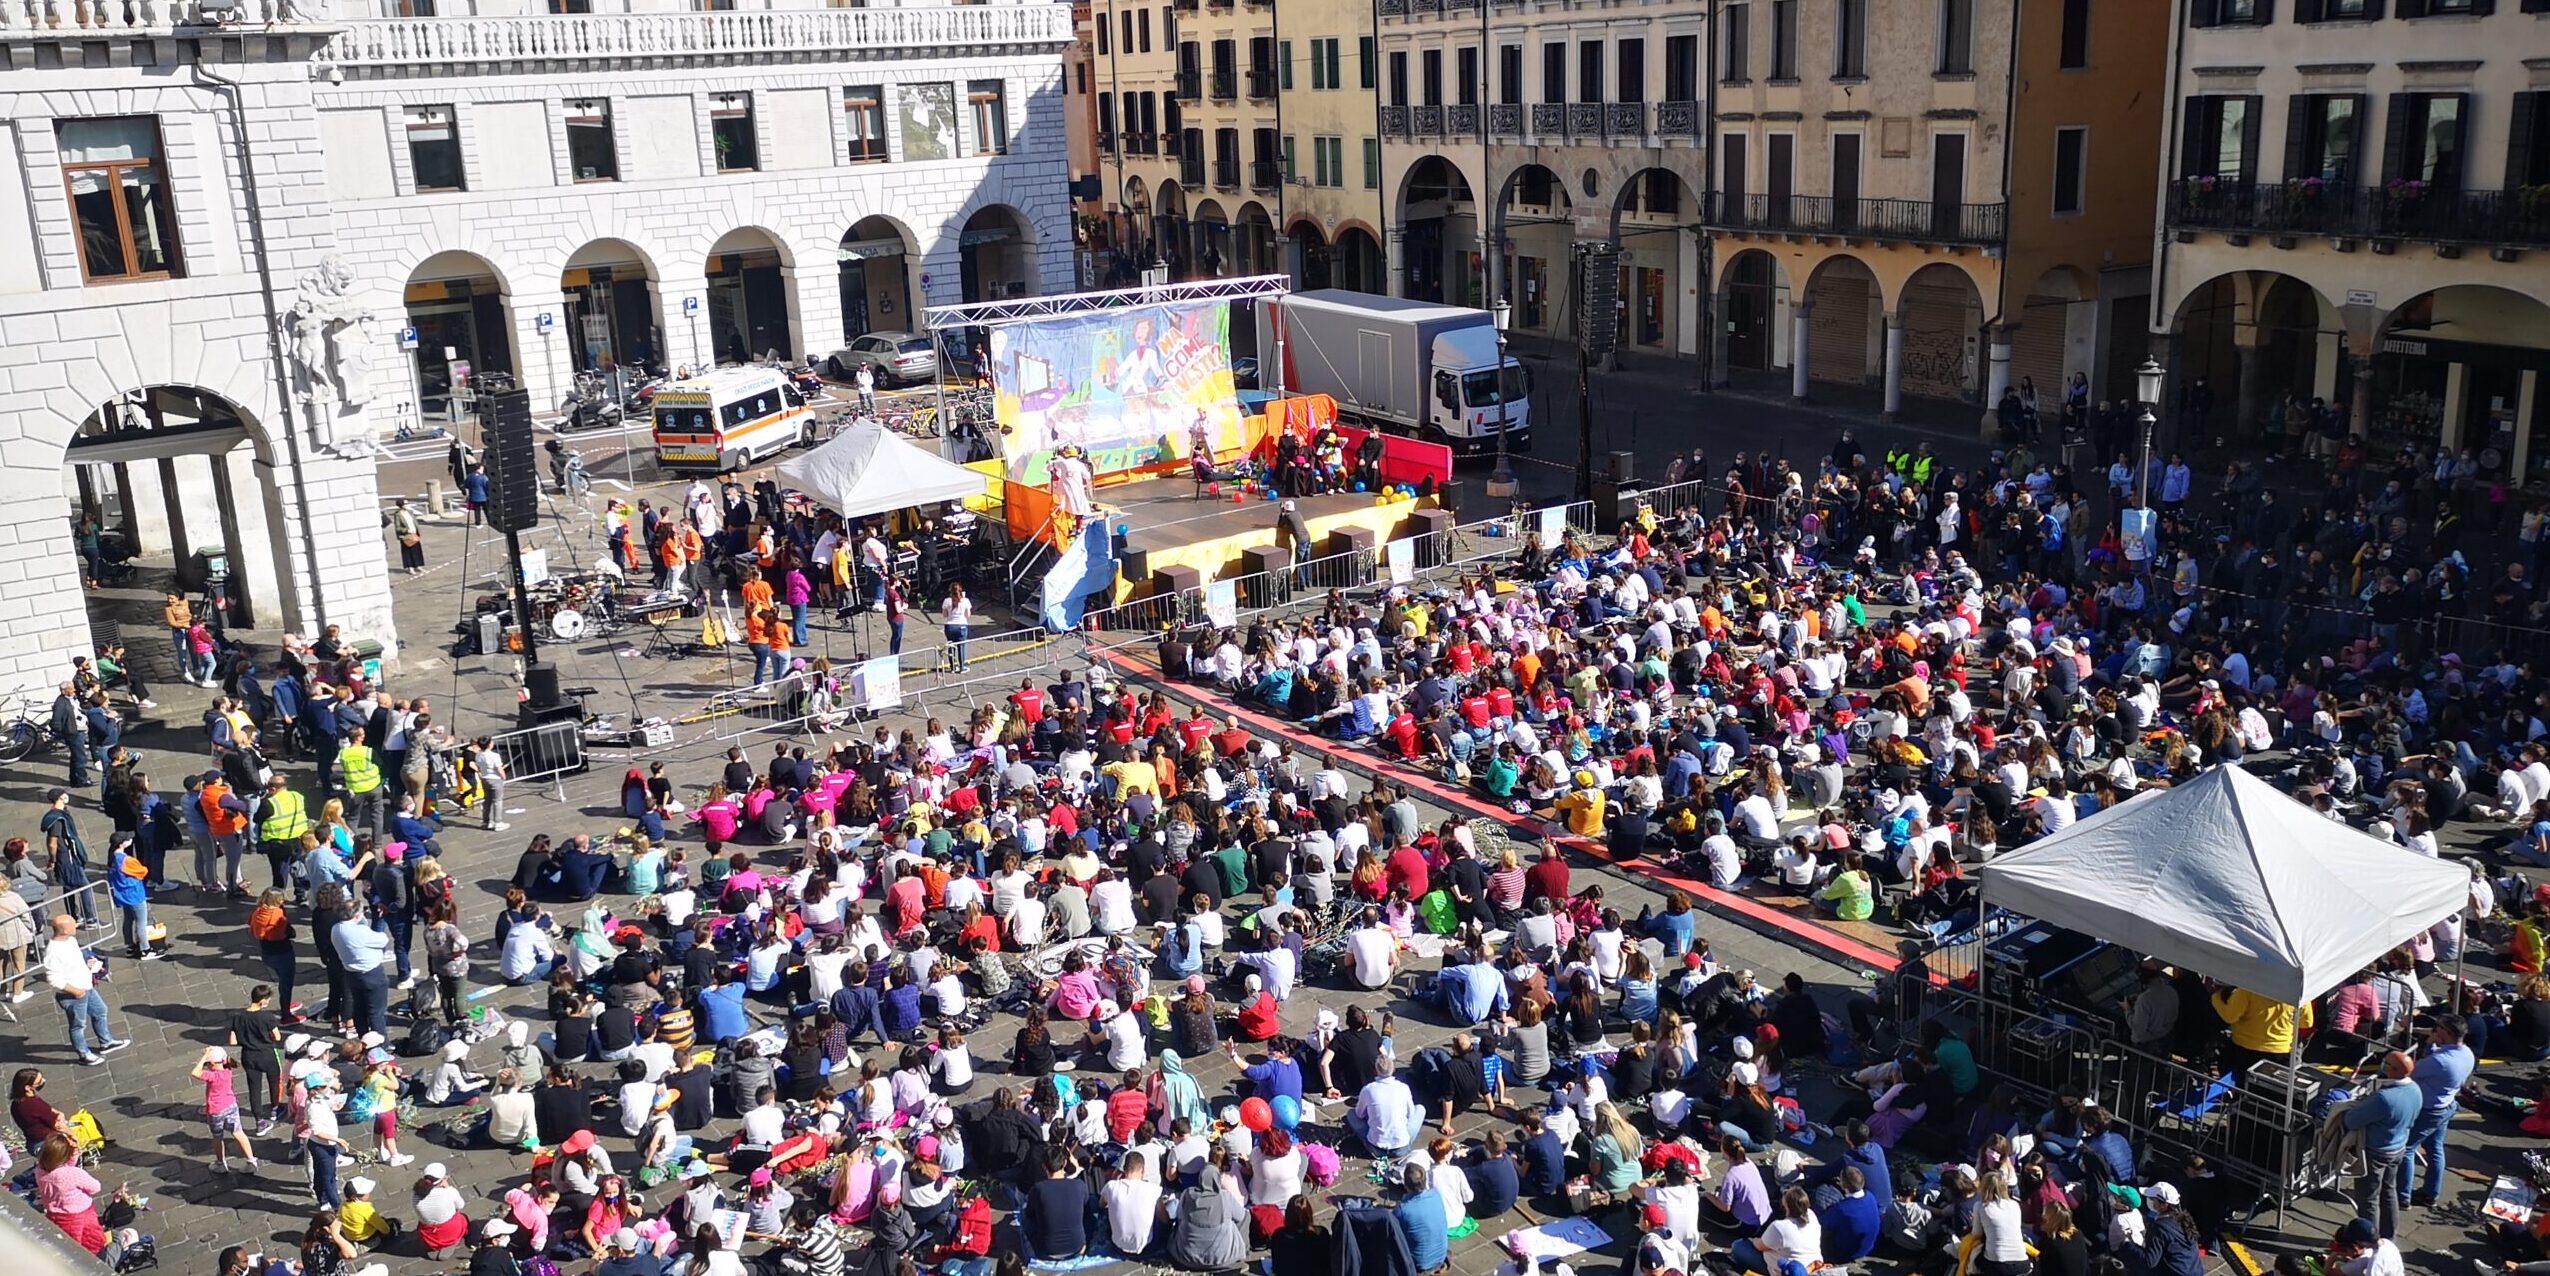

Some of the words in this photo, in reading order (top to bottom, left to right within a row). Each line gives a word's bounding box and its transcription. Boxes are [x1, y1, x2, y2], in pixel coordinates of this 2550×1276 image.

[403, 329, 414, 341] P
[1158, 328, 1184, 355] MA
[1165, 332, 1206, 378] COME
[1175, 344, 1225, 392] VESTI?
